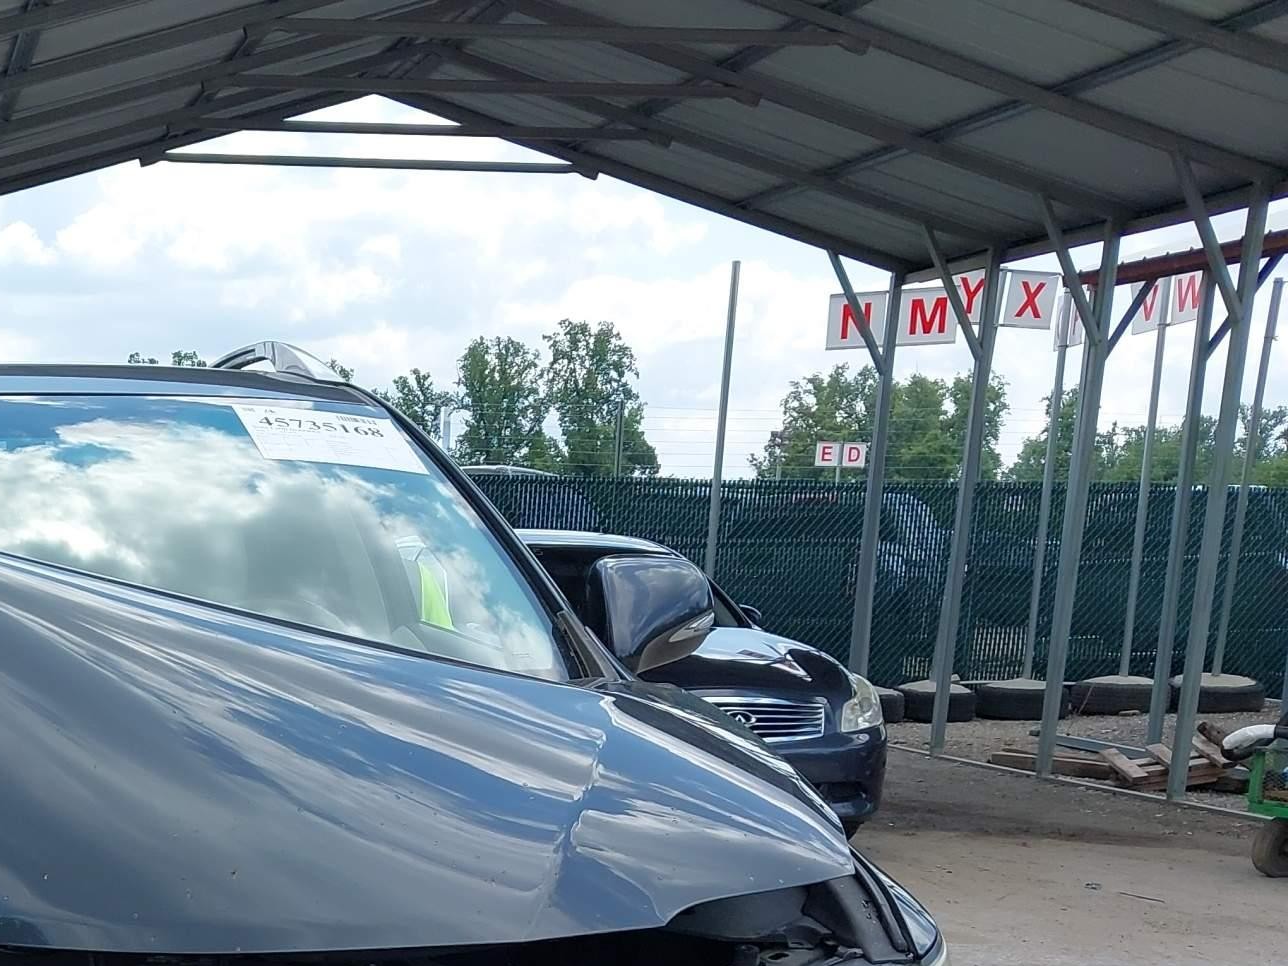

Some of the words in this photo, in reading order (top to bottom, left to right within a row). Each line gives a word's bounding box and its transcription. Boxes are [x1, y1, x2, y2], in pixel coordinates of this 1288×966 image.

[960, 276, 985, 315] Y
[1014, 281, 1047, 319] X
[840, 302, 872, 340] N
[908, 297, 948, 336] M
[258, 416, 385, 438] 45735168
[821, 446, 833, 462] E
[848, 446, 861, 462] D
